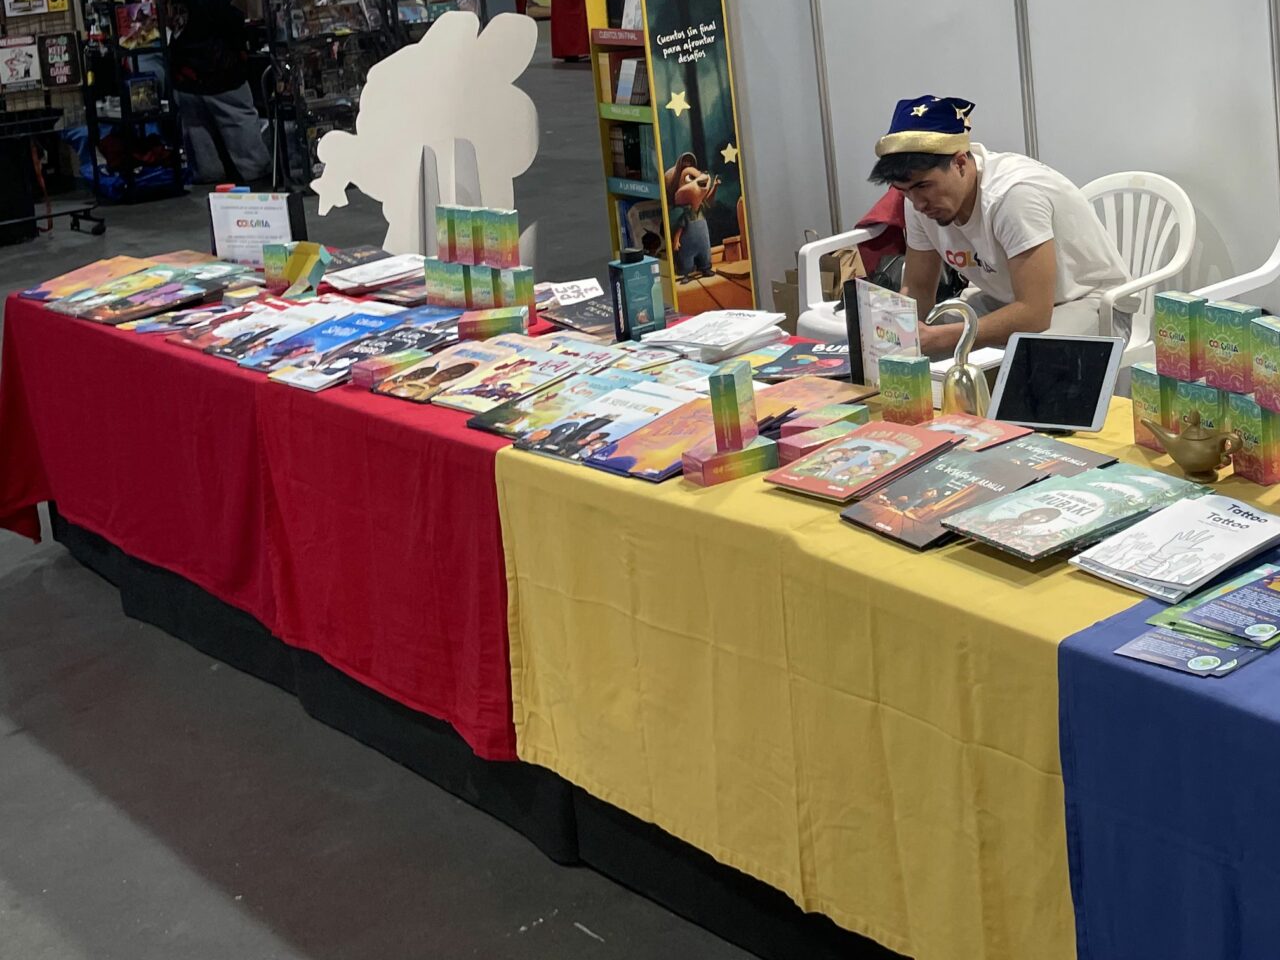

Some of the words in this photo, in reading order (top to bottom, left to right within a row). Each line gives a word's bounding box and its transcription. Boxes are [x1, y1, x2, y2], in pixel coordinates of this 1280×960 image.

[656, 30, 686, 46] Cuentos
[686, 26, 698, 37] sin
[699, 20, 717, 37] final
[663, 44, 681, 59] para
[683, 35, 716, 52] afrontar
[1209, 340, 1238, 352] COLORIA
[1034, 494, 1096, 516] MUBAKI
[1227, 504, 1268, 524] Tattoo
[1206, 512, 1250, 529] Tattoo
